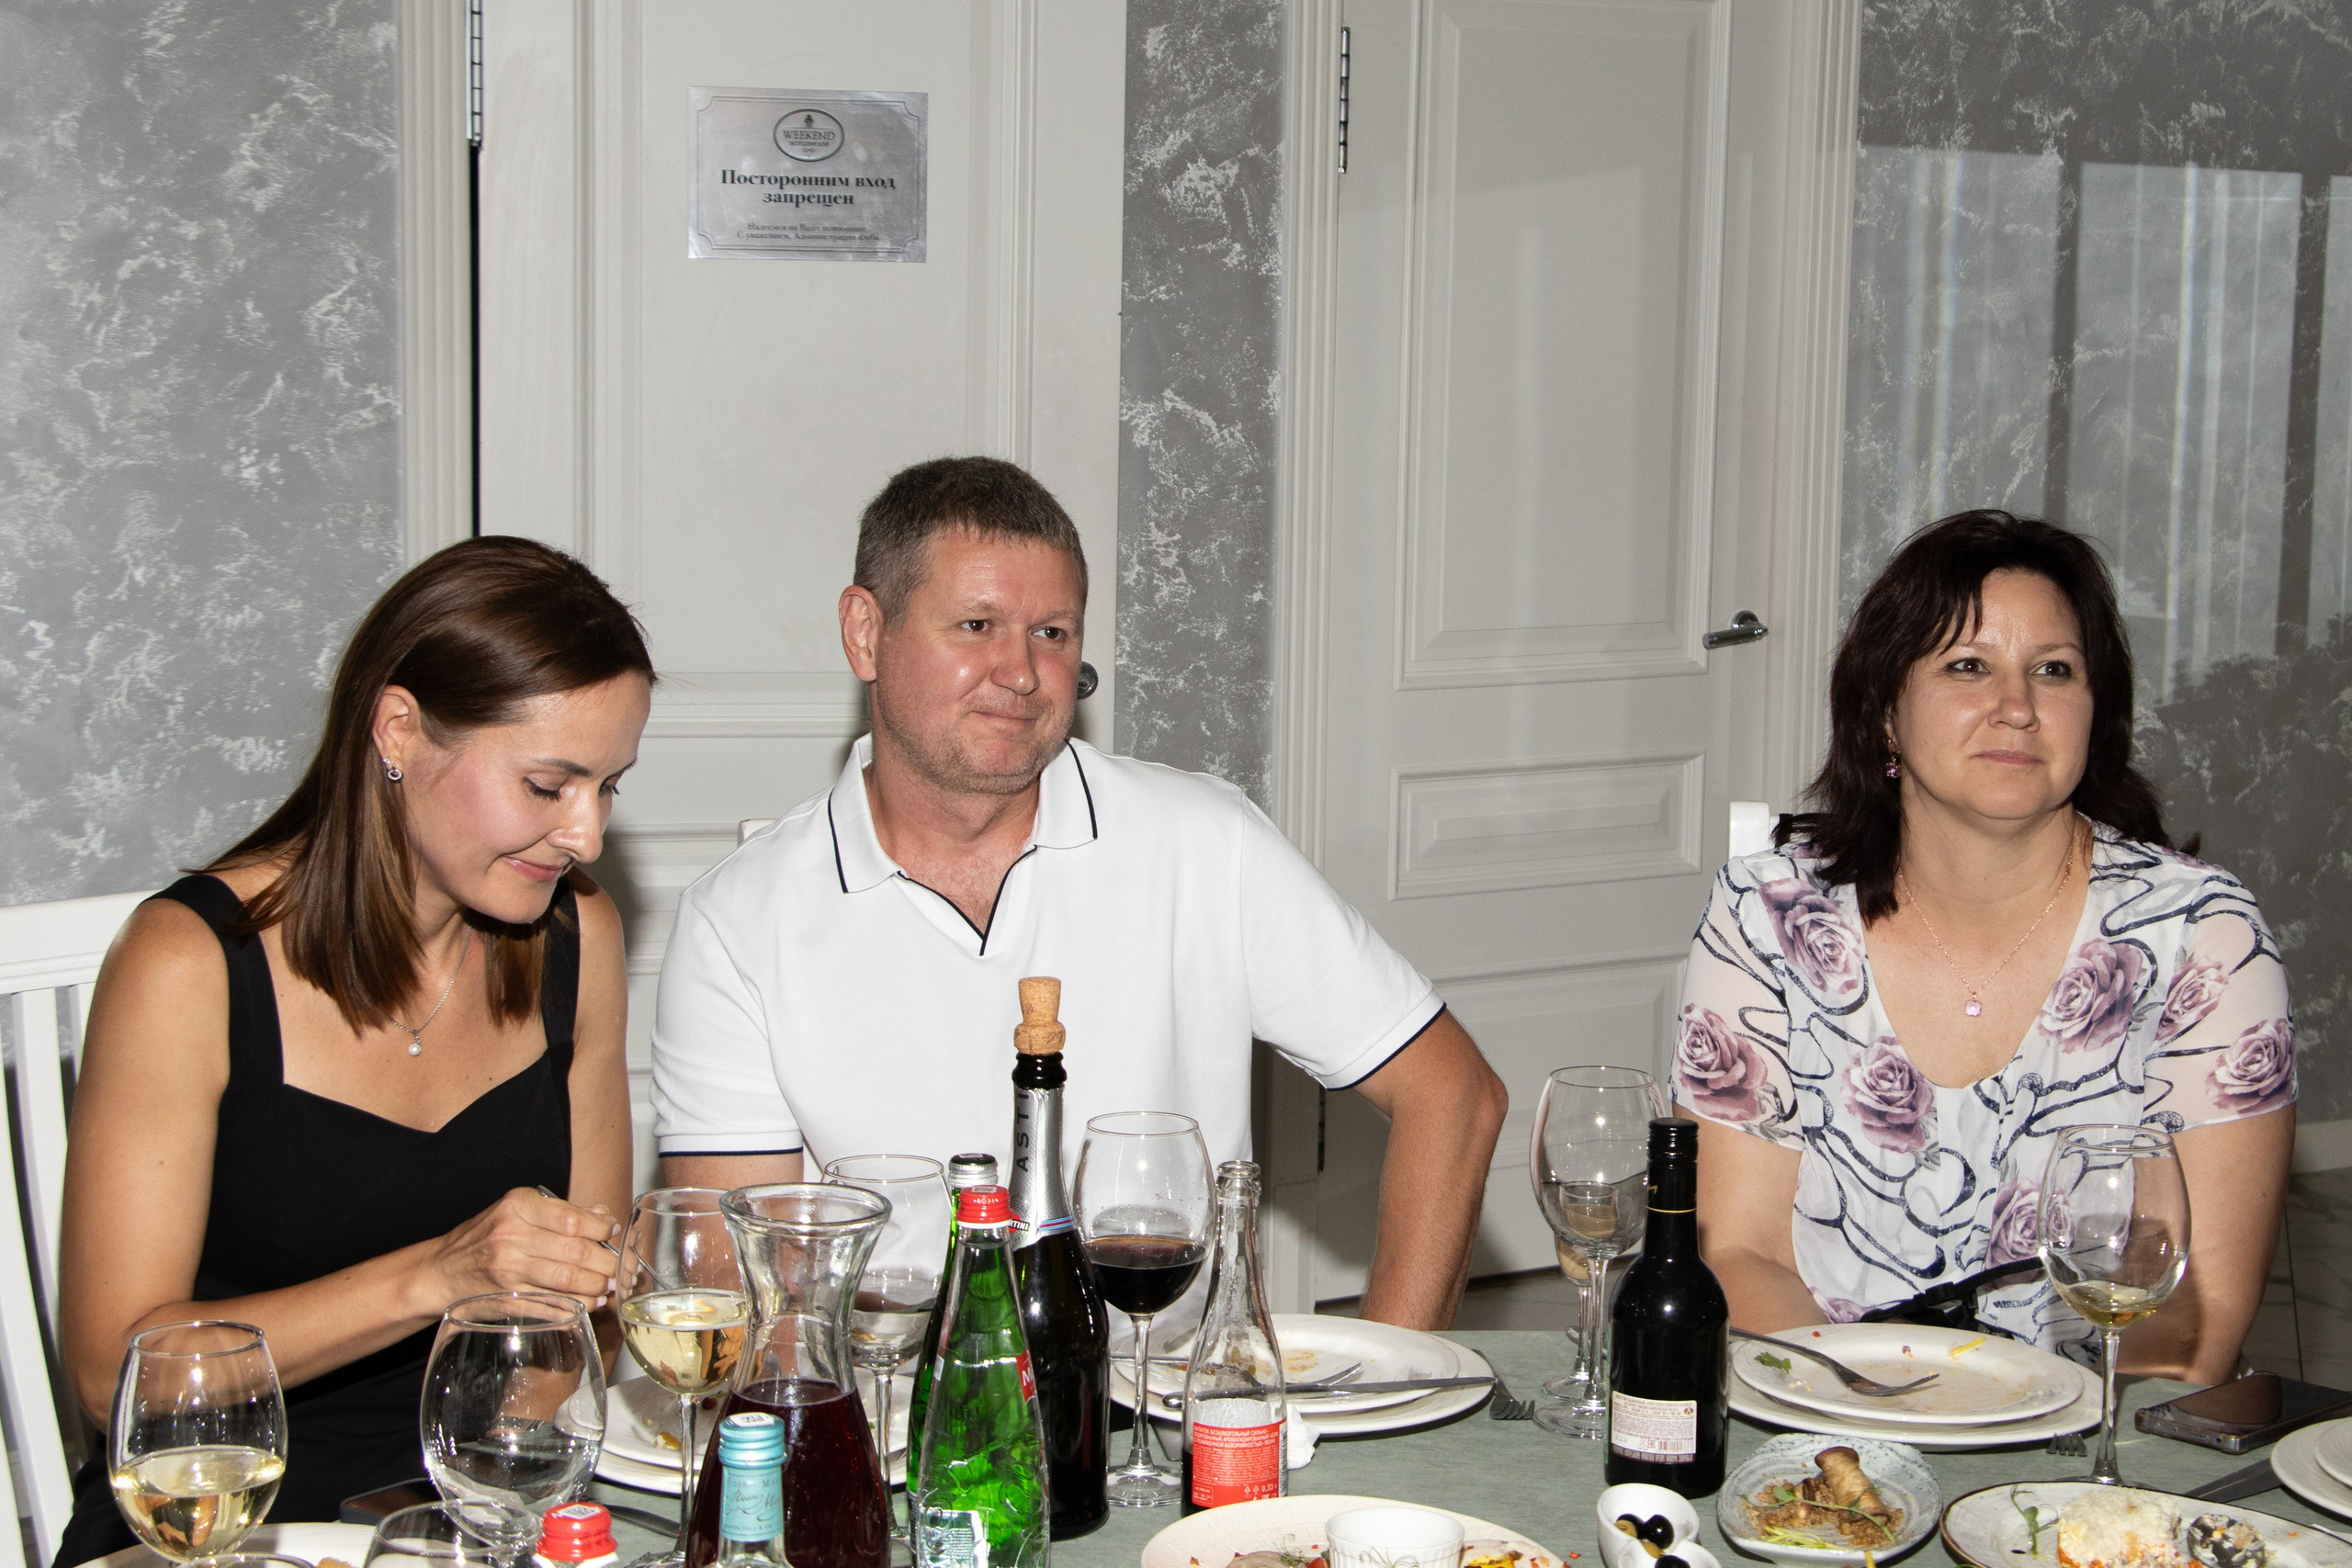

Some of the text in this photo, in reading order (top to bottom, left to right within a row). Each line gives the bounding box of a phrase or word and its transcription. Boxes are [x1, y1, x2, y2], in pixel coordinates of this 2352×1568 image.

[783, 130, 835, 141] WEEKEND
[721, 168, 897, 189] Посторонним вход
[763, 192, 854, 209] запрещен
[1015, 1092, 1030, 1173] ASTI
